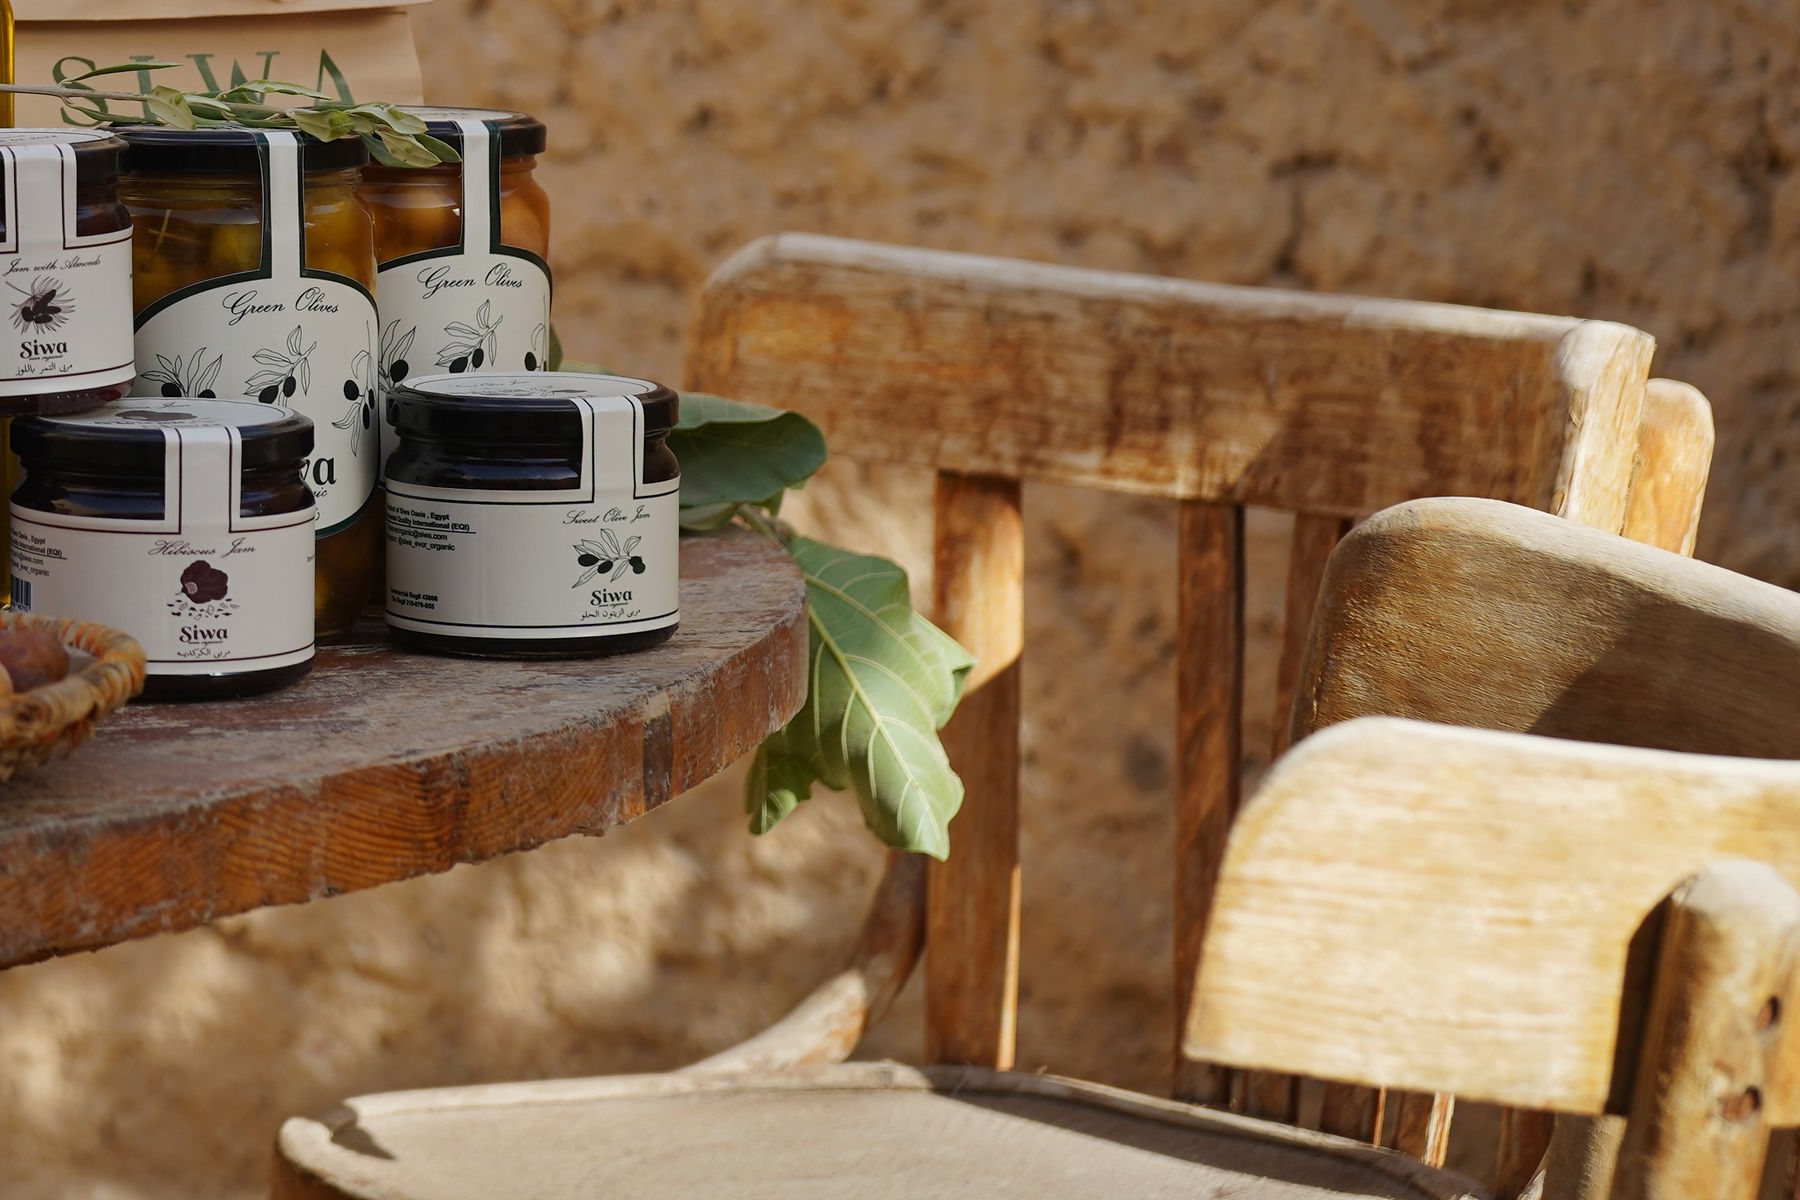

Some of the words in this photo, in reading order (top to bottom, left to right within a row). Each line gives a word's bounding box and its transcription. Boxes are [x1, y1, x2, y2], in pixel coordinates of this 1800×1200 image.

[2, 257, 31, 277] Jam
[33, 258, 57, 272] with
[60, 254, 102, 270] Almonds
[416, 265, 477, 301] Green
[484, 262, 523, 289] Olives
[222, 289, 286, 327] Green
[294, 287, 340, 314] Olives
[19, 339, 68, 360] Siwa
[430, 512, 450, 522] Egypt
[562, 509, 600, 525] Sweet
[602, 506, 628, 523] Olive
[630, 504, 651, 524] Jam
[451, 522, 470, 532] (EQI)
[148, 539, 216, 556] Hibiscus
[220, 537, 257, 558] Jam
[589, 588, 633, 606] Siwa
[178, 624, 229, 643] Siwa
